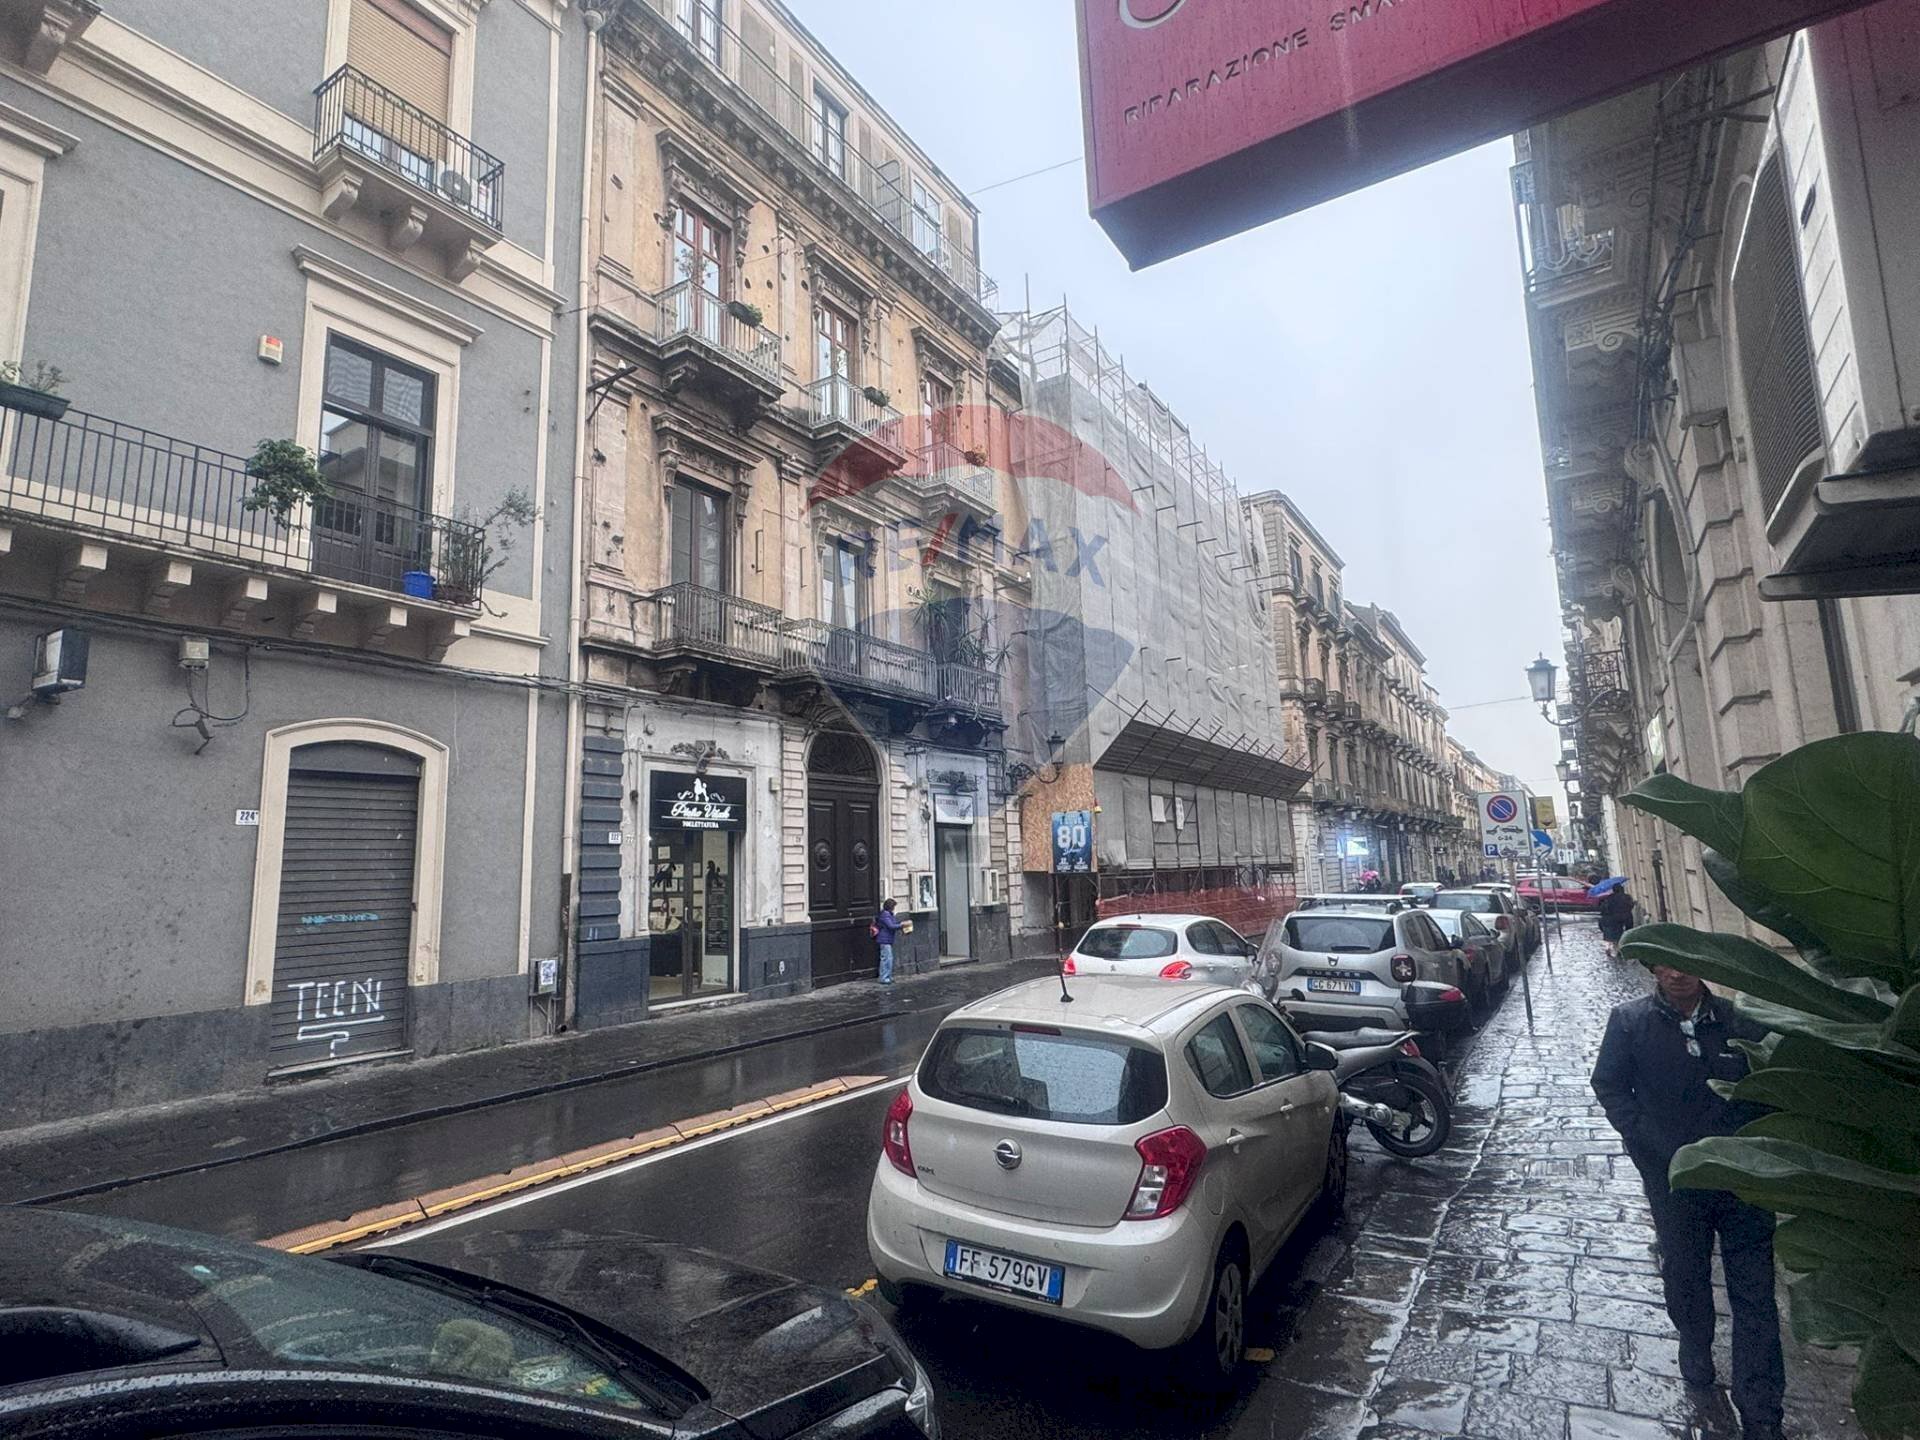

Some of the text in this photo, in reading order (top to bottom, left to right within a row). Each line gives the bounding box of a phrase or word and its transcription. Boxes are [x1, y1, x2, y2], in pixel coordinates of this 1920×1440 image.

[1124, 0, 1398, 125] RIPARAZIONE SMA
[1057, 825, 1086, 848] 80
[959, 1249, 981, 1274] FF
[988, 1255, 1048, 1292] 579GV
